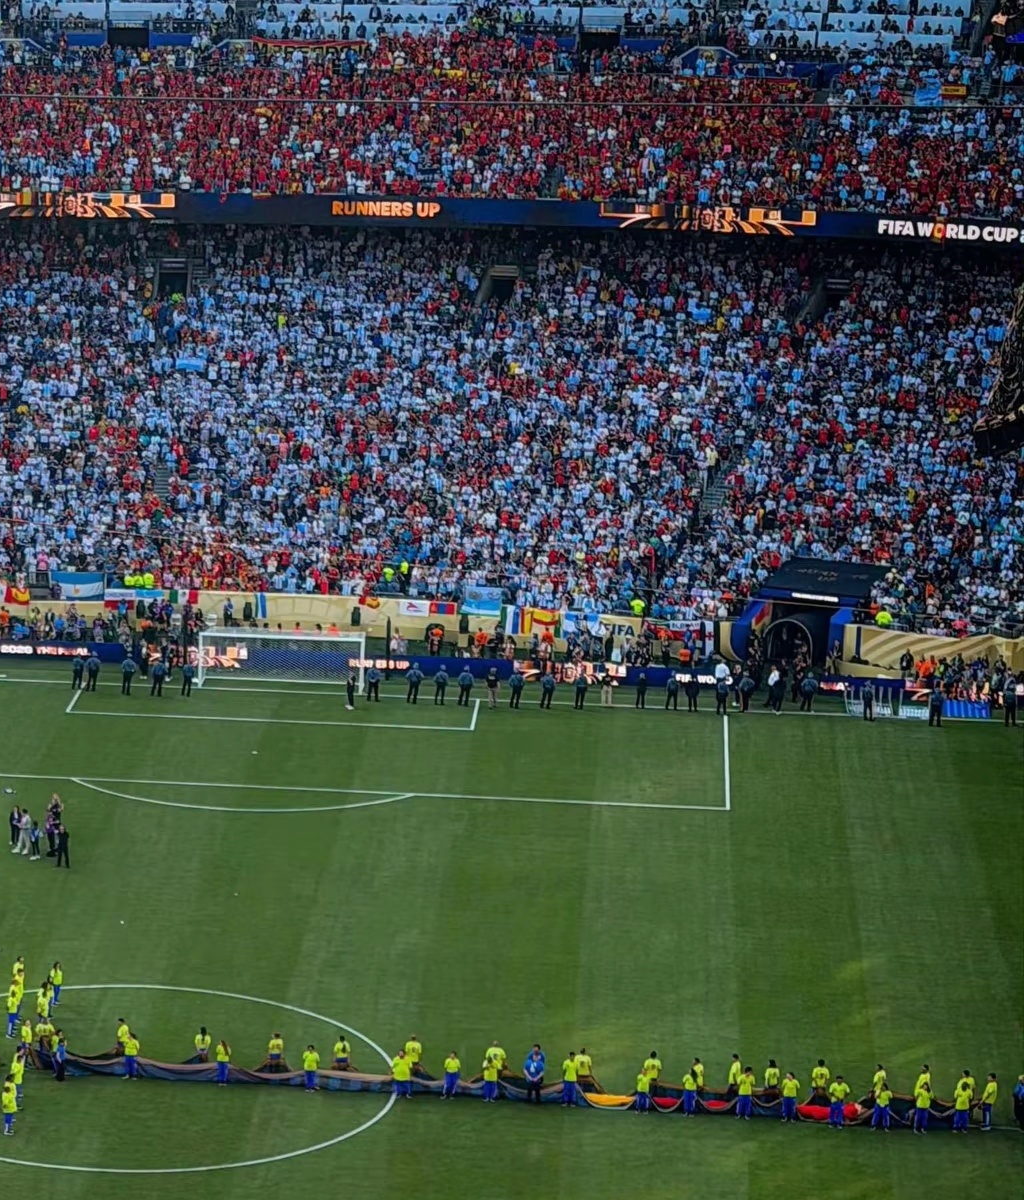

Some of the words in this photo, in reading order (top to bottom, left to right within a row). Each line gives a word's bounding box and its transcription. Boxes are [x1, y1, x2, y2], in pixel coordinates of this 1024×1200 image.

[332, 200, 414, 217] RUNNERS
[416, 202, 441, 217] UP
[877, 219, 915, 237] FIFA
[917, 221, 981, 240] WORLD
[982, 225, 1019, 243] CUP
[603, 623, 636, 637] FIFA
[396, 660, 410, 669] UP
